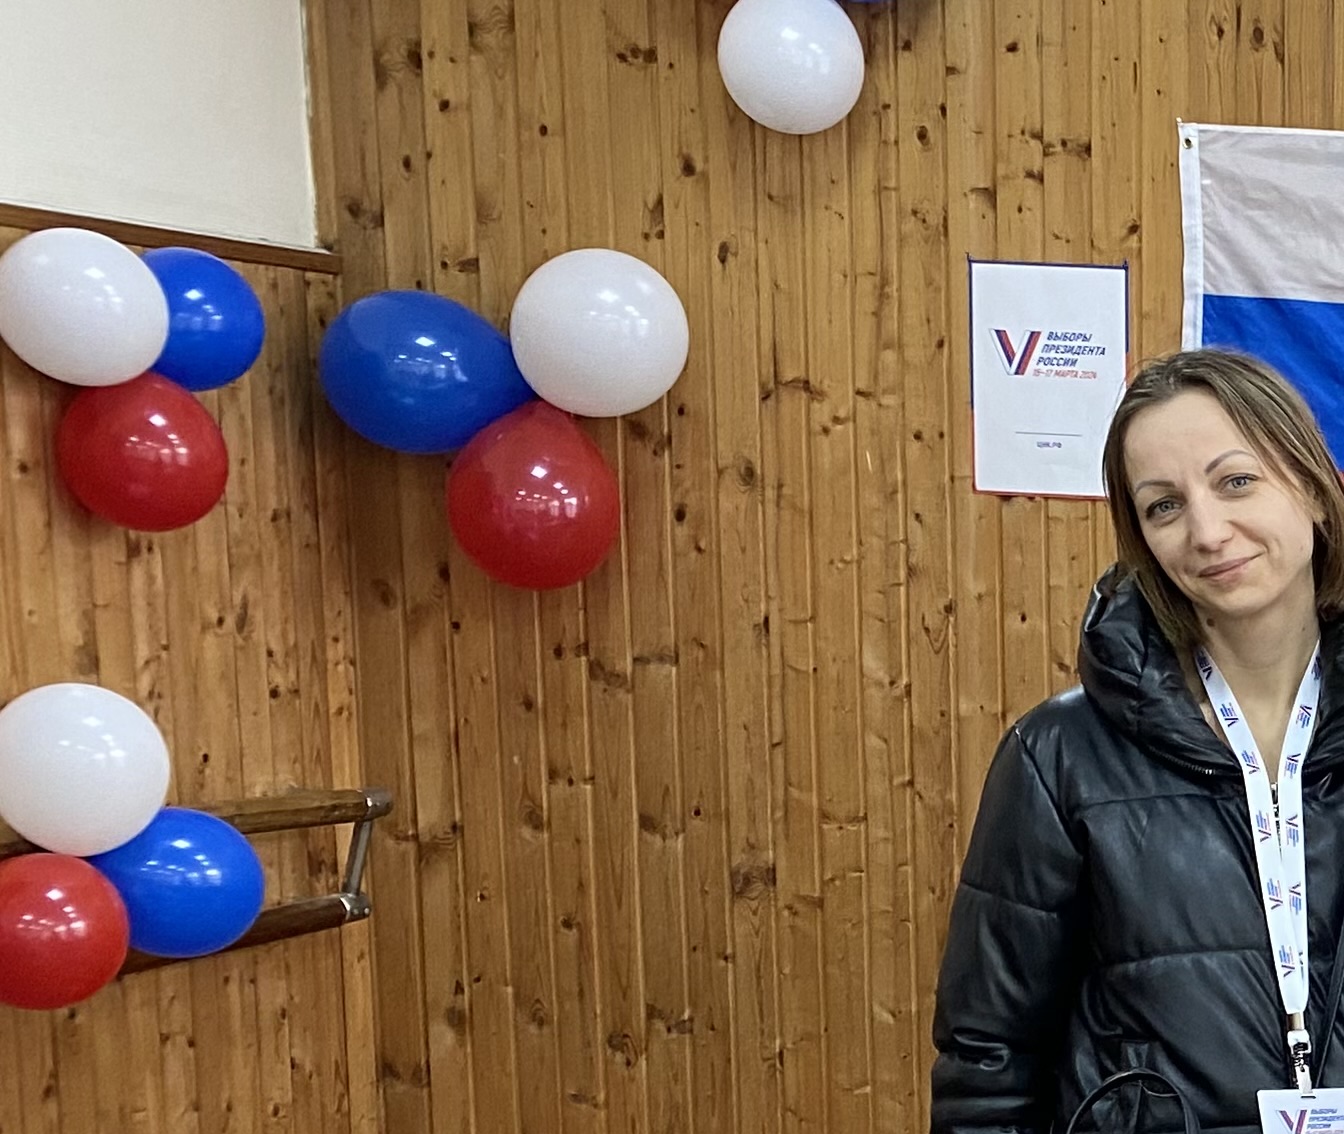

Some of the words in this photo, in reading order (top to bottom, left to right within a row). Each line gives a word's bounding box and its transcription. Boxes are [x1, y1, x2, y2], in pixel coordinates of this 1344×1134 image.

[1047, 331, 1093, 341] ВЫБОРЫ
[1041, 344, 1106, 356] ПРЕЗИДЕНТА
[1036, 357, 1078, 367] РОССИИ
